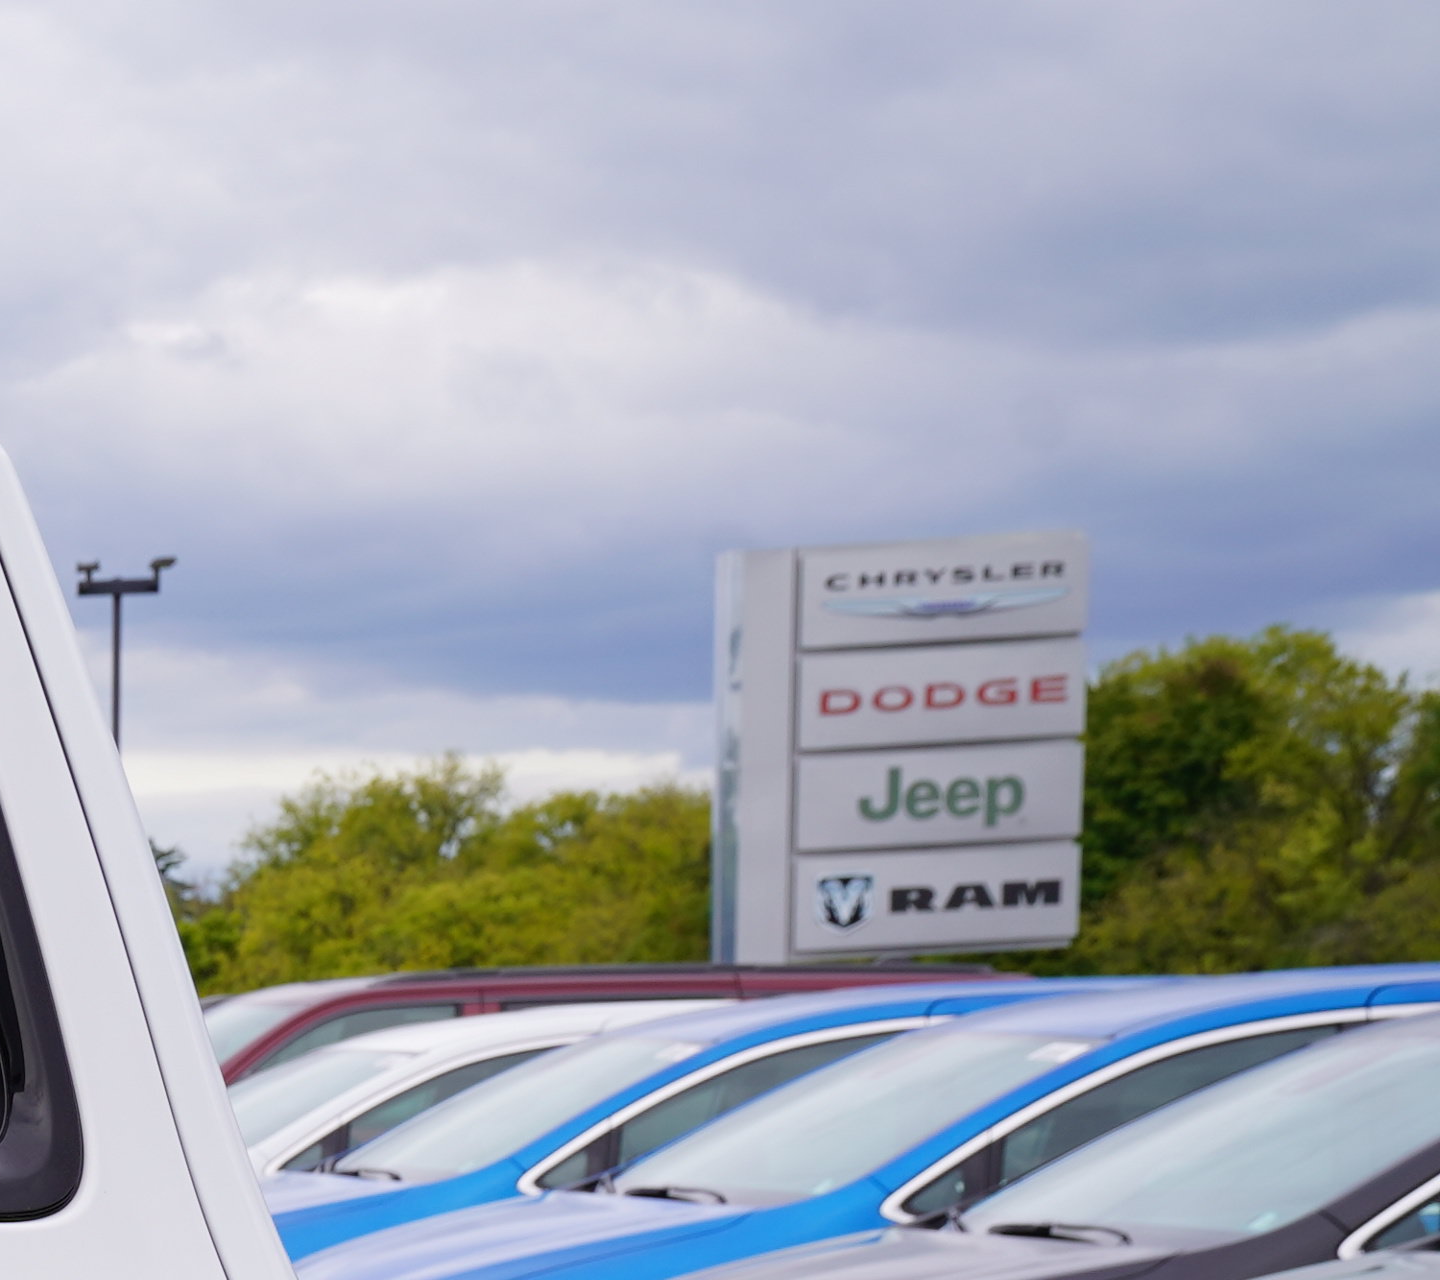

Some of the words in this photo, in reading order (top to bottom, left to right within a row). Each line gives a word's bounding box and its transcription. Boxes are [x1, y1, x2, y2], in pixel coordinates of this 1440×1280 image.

[824, 559, 1067, 592] CHRYSLER
[819, 674, 1070, 717] DODGE
[857, 766, 1025, 827] Jeep
[889, 878, 1062, 913] RAM
